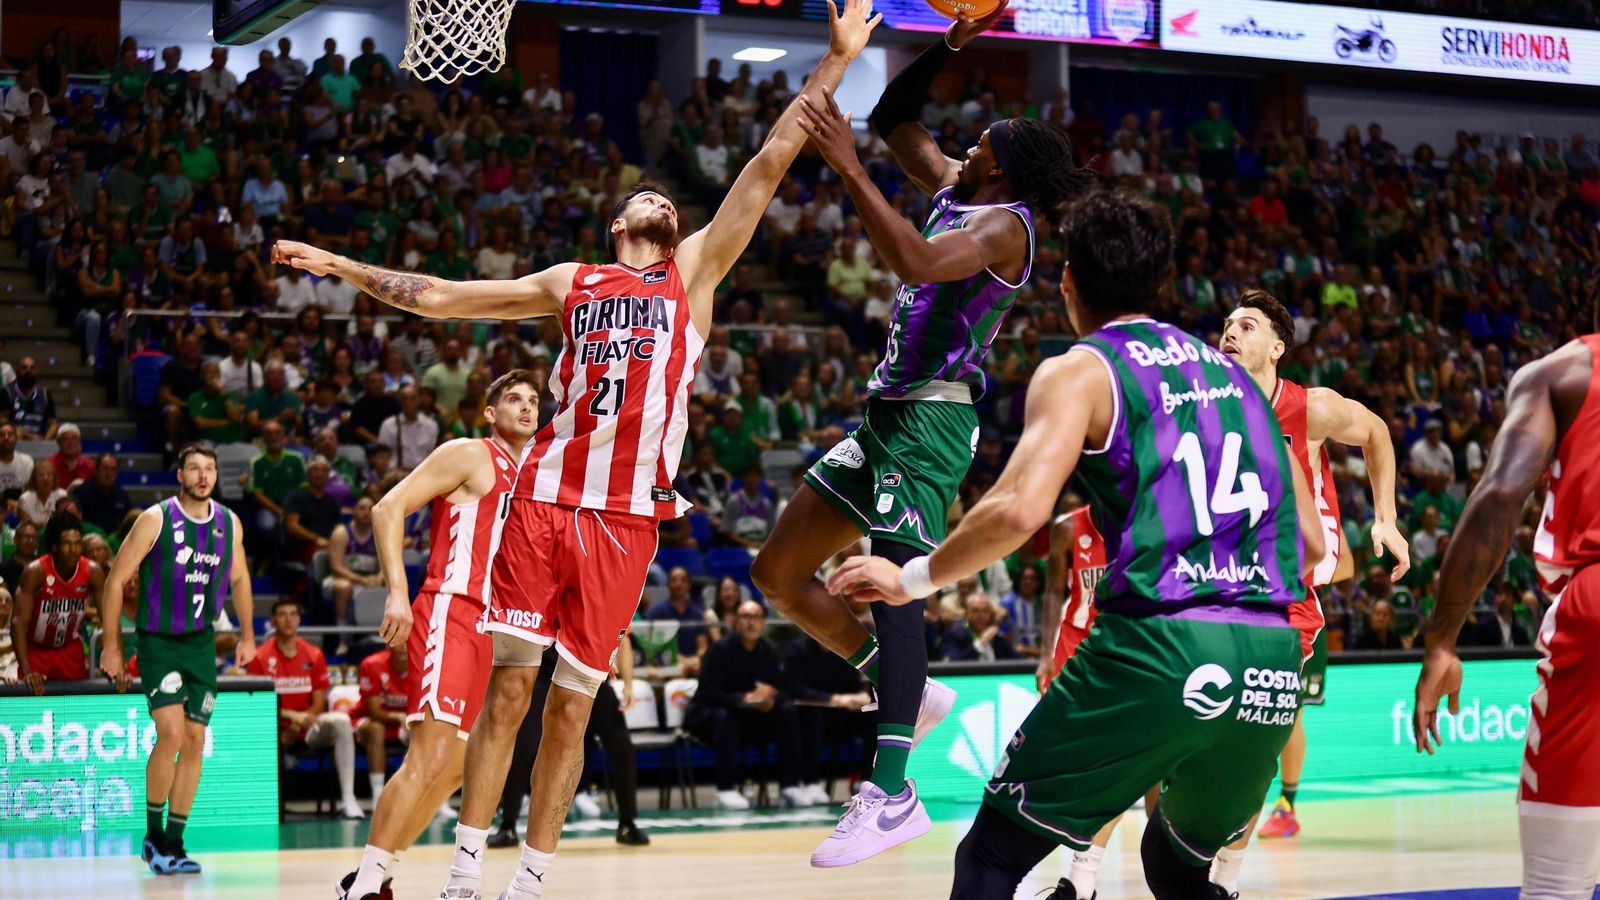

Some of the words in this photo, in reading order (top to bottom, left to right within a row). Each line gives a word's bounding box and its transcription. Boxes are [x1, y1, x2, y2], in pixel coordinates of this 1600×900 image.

[1013, 9, 1091, 38] GIRONA
[574, 295, 669, 341] GIRONA
[580, 336, 656, 366] FIATC
[589, 376, 625, 417] 21
[1173, 432, 1269, 536] 14
[42, 598, 86, 613] GIRONA
[192, 594, 205, 619] 7
[505, 608, 543, 630] YOSO
[1243, 667, 1301, 691] COSTA
[1241, 689, 1274, 708] DEL
[1275, 692, 1298, 709] SOL
[1236, 706, 1295, 726] MÁLAGA
